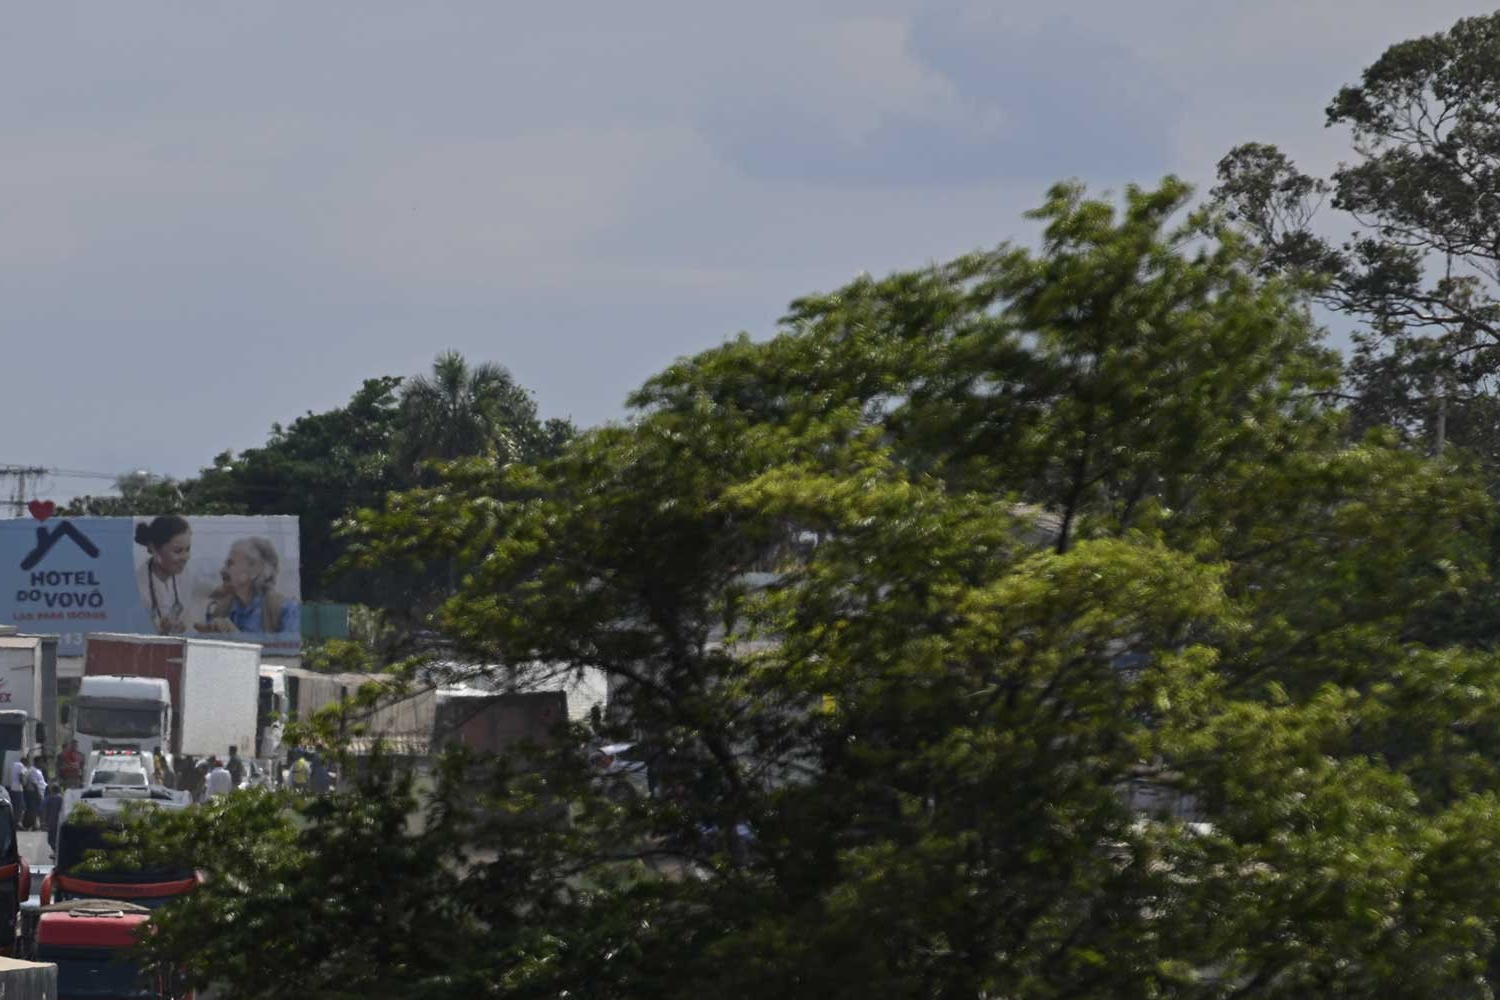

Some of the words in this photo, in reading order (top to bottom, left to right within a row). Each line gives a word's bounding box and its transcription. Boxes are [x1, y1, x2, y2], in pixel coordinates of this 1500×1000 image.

[31, 570, 99, 586] HOTEL
[17, 590, 40, 602] DO
[45, 588, 104, 608] VOVÔ
